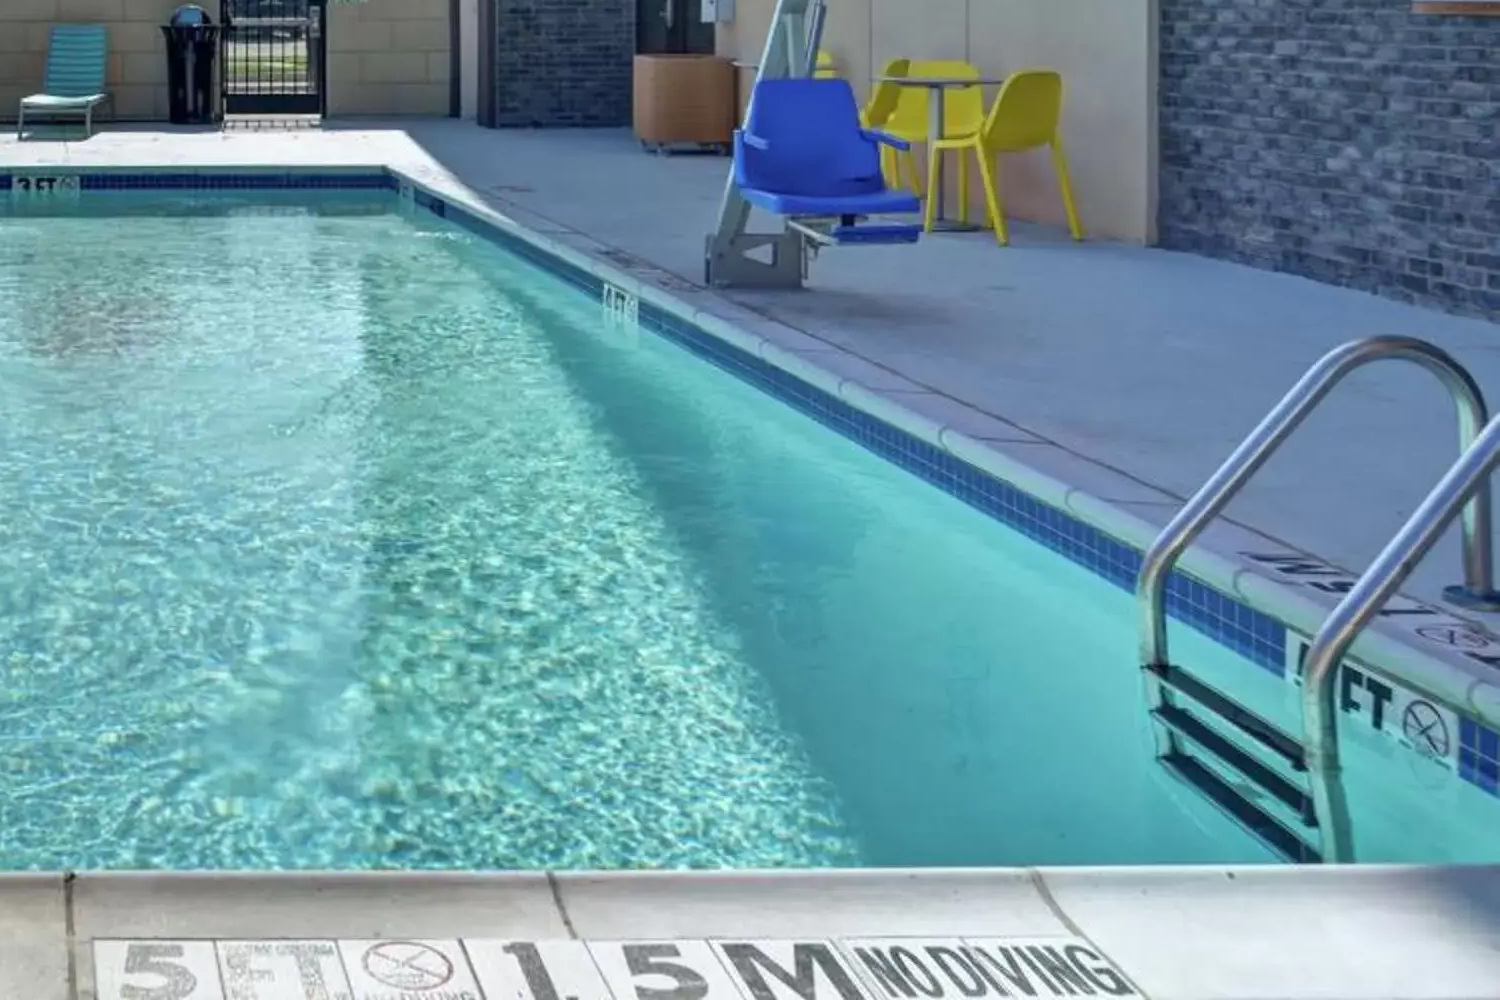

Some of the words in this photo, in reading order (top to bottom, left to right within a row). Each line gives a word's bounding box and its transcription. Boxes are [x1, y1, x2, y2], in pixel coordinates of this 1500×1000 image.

[1341, 662, 1393, 732] FT
[119, 943, 198, 1000] 5
[719, 942, 872, 1000] M
[853, 945, 945, 998] NO
[923, 944, 1136, 997] DIVING
